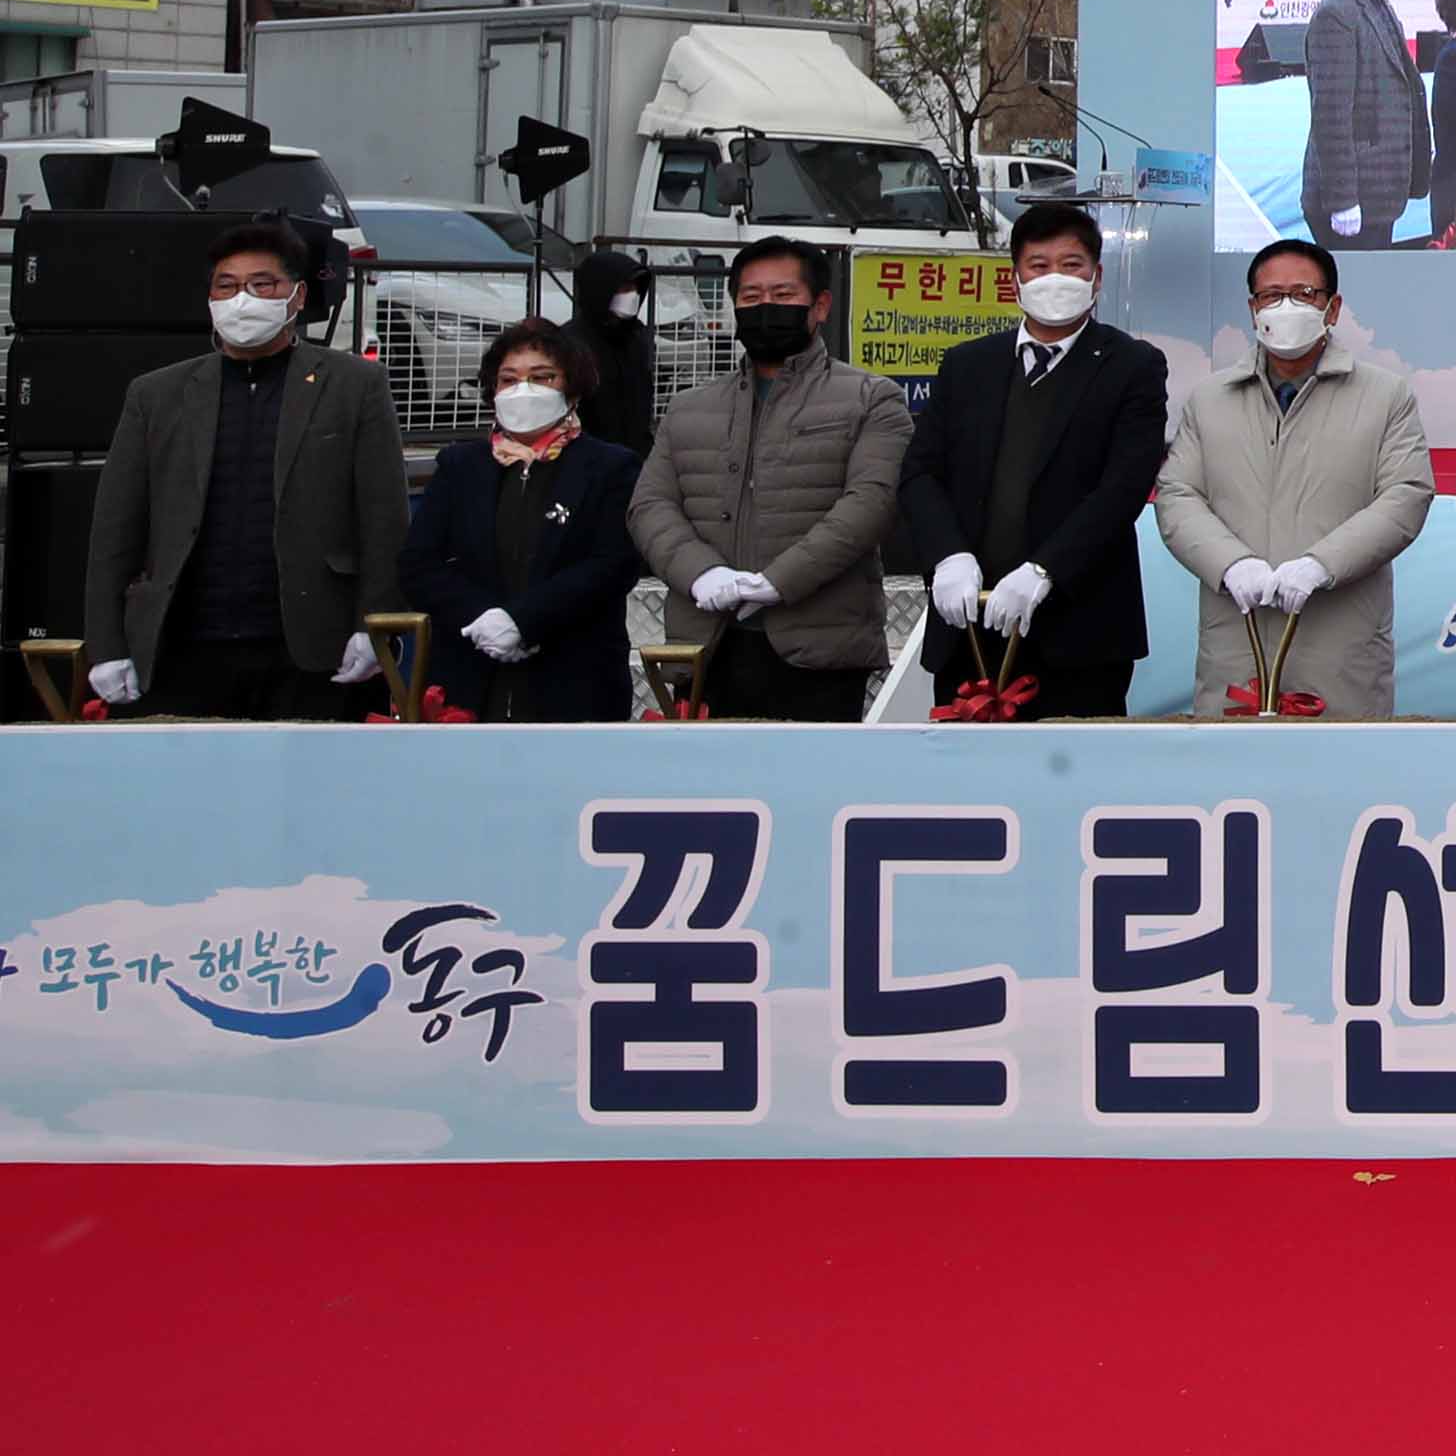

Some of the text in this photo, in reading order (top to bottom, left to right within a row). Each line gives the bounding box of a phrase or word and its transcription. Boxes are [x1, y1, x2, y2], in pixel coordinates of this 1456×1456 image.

[39, 903, 544, 1063] 모두가 행복한 동구
